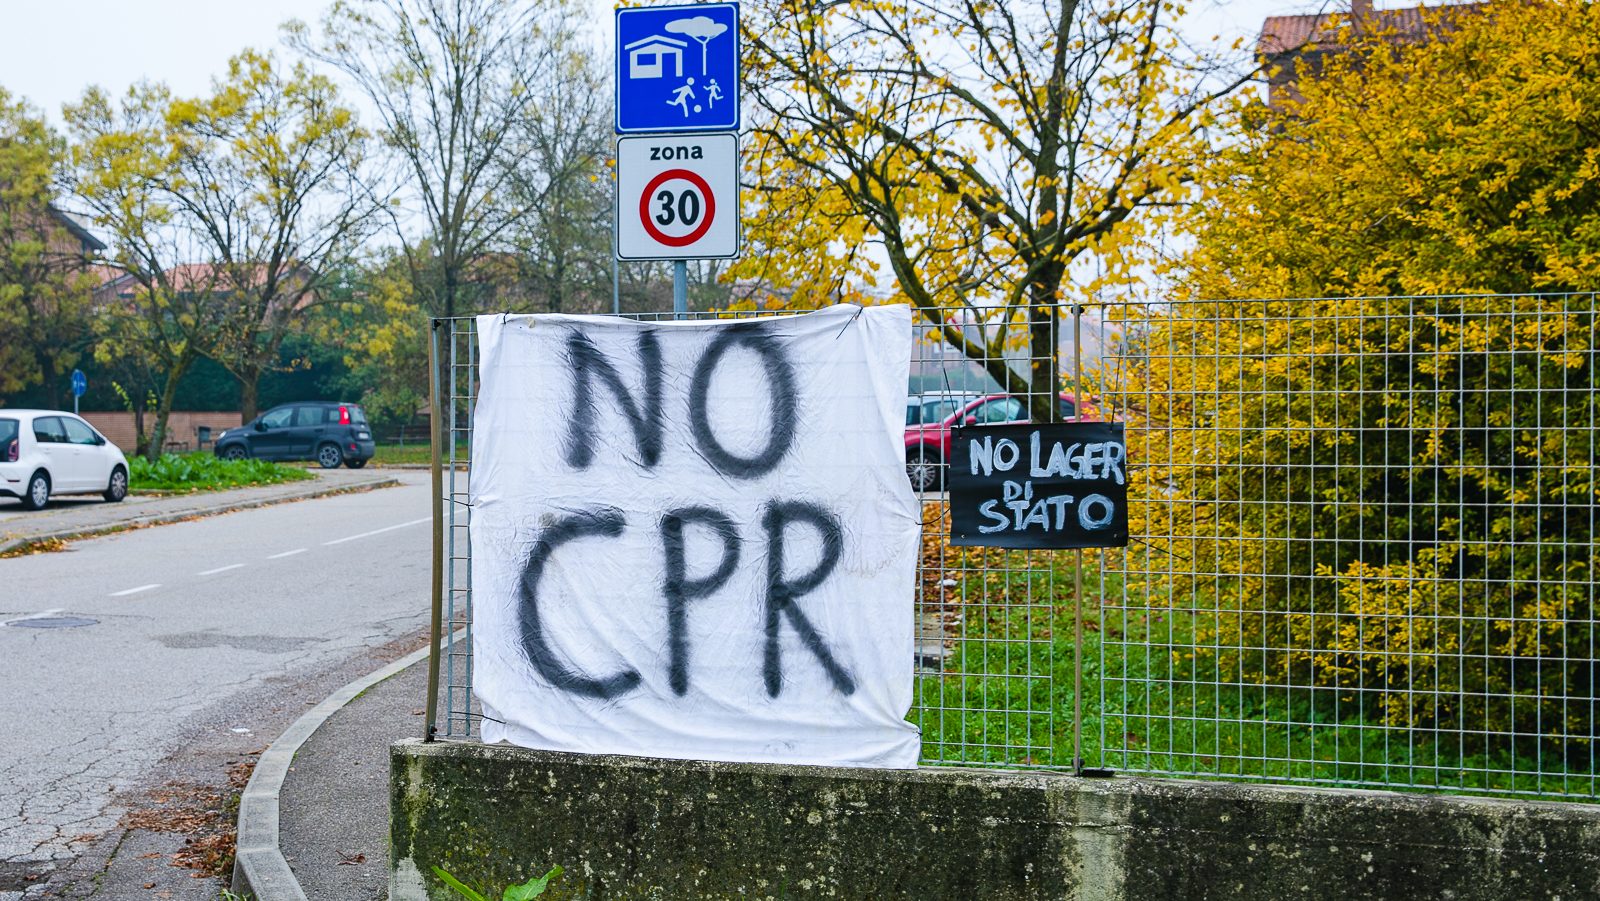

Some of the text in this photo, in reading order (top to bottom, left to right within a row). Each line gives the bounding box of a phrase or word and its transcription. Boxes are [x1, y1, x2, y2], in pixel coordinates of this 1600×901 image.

[650, 145, 703, 160] zona
[656, 189, 700, 226] 30
[563, 322, 797, 480] NO
[969, 430, 1125, 485] NO LAGER
[1002, 480, 1034, 502] DI
[977, 493, 1115, 534] STATO
[518, 498, 857, 700] CPR
